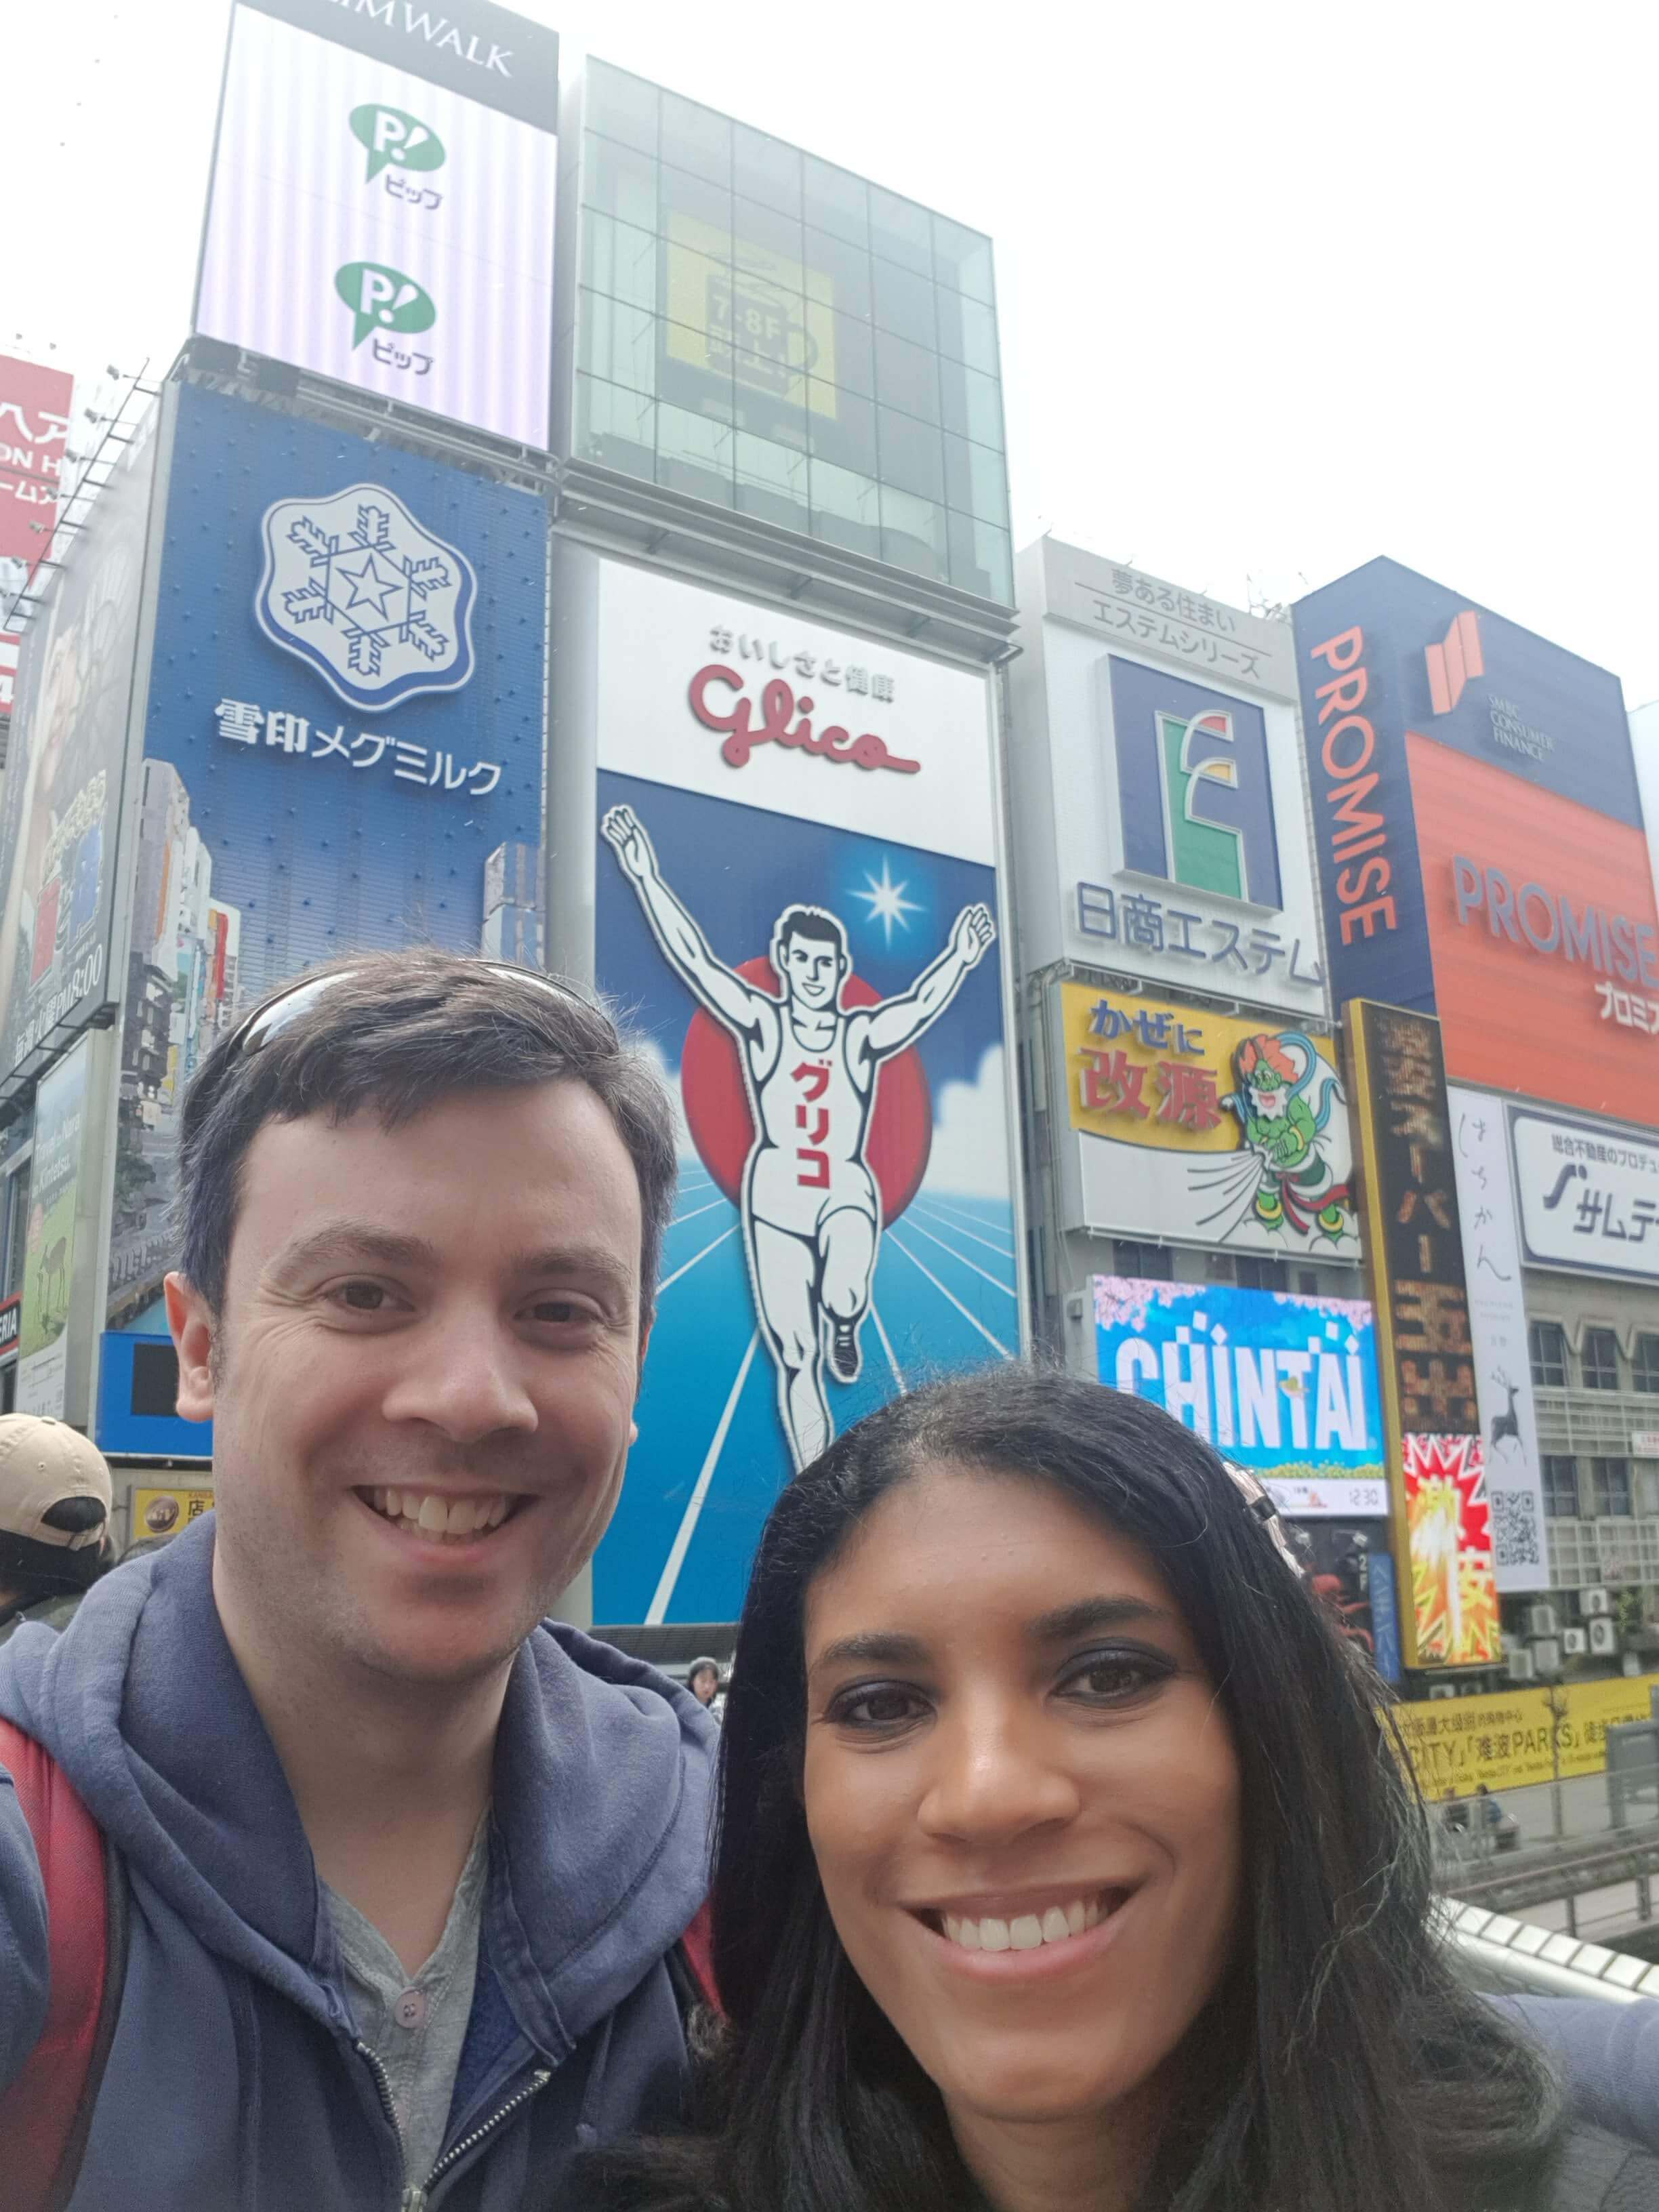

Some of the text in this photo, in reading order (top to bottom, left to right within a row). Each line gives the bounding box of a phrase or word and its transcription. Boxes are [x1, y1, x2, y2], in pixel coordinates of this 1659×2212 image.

[384, 174, 443, 210] ピップ
[371, 337, 434, 375] ピップ
[1092, 600, 1261, 680] エステムシリーズ
[1110, 568, 1236, 633] 夢ある住まい
[709, 624, 895, 703] おいしさと健康
[214, 697, 501, 795] 雪印メグミルク
[689, 663, 922, 769] Glico
[1311, 626, 1397, 947] PROMISE
[1076, 880, 1327, 987] 日商エステム
[1452, 853, 1659, 985] PROMISE
[1088, 999, 1206, 1055] かぜに
[790, 1059, 834, 1191] グリコ
[1079, 1047, 1222, 1132] 改源
[1573, 1187, 1659, 1242] サムテ
